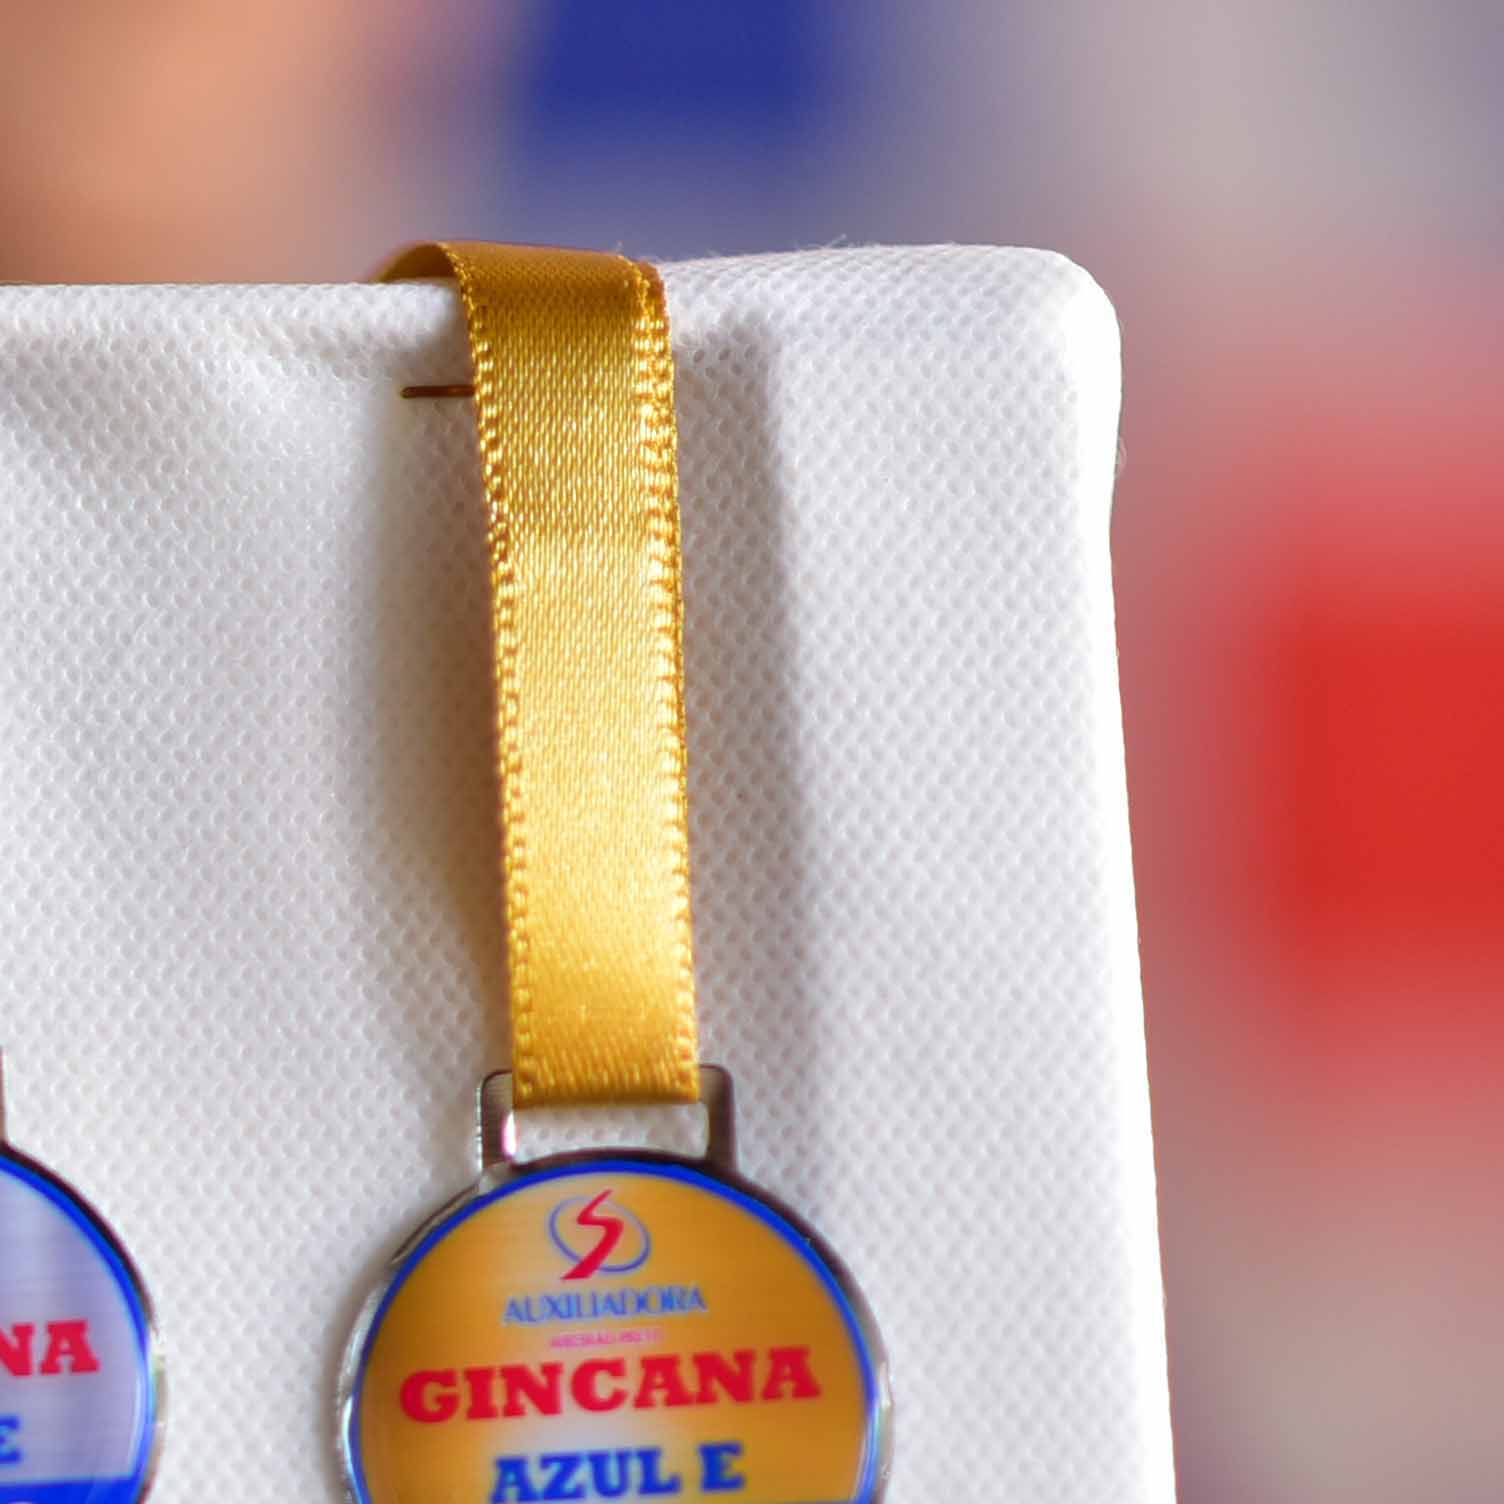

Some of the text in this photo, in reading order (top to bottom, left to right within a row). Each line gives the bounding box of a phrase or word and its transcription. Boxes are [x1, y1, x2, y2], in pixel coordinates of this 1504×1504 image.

[502, 1285, 708, 1324] AUXILIADORA
[399, 1346, 821, 1424] GINCANA
[699, 1441, 745, 1493] E
